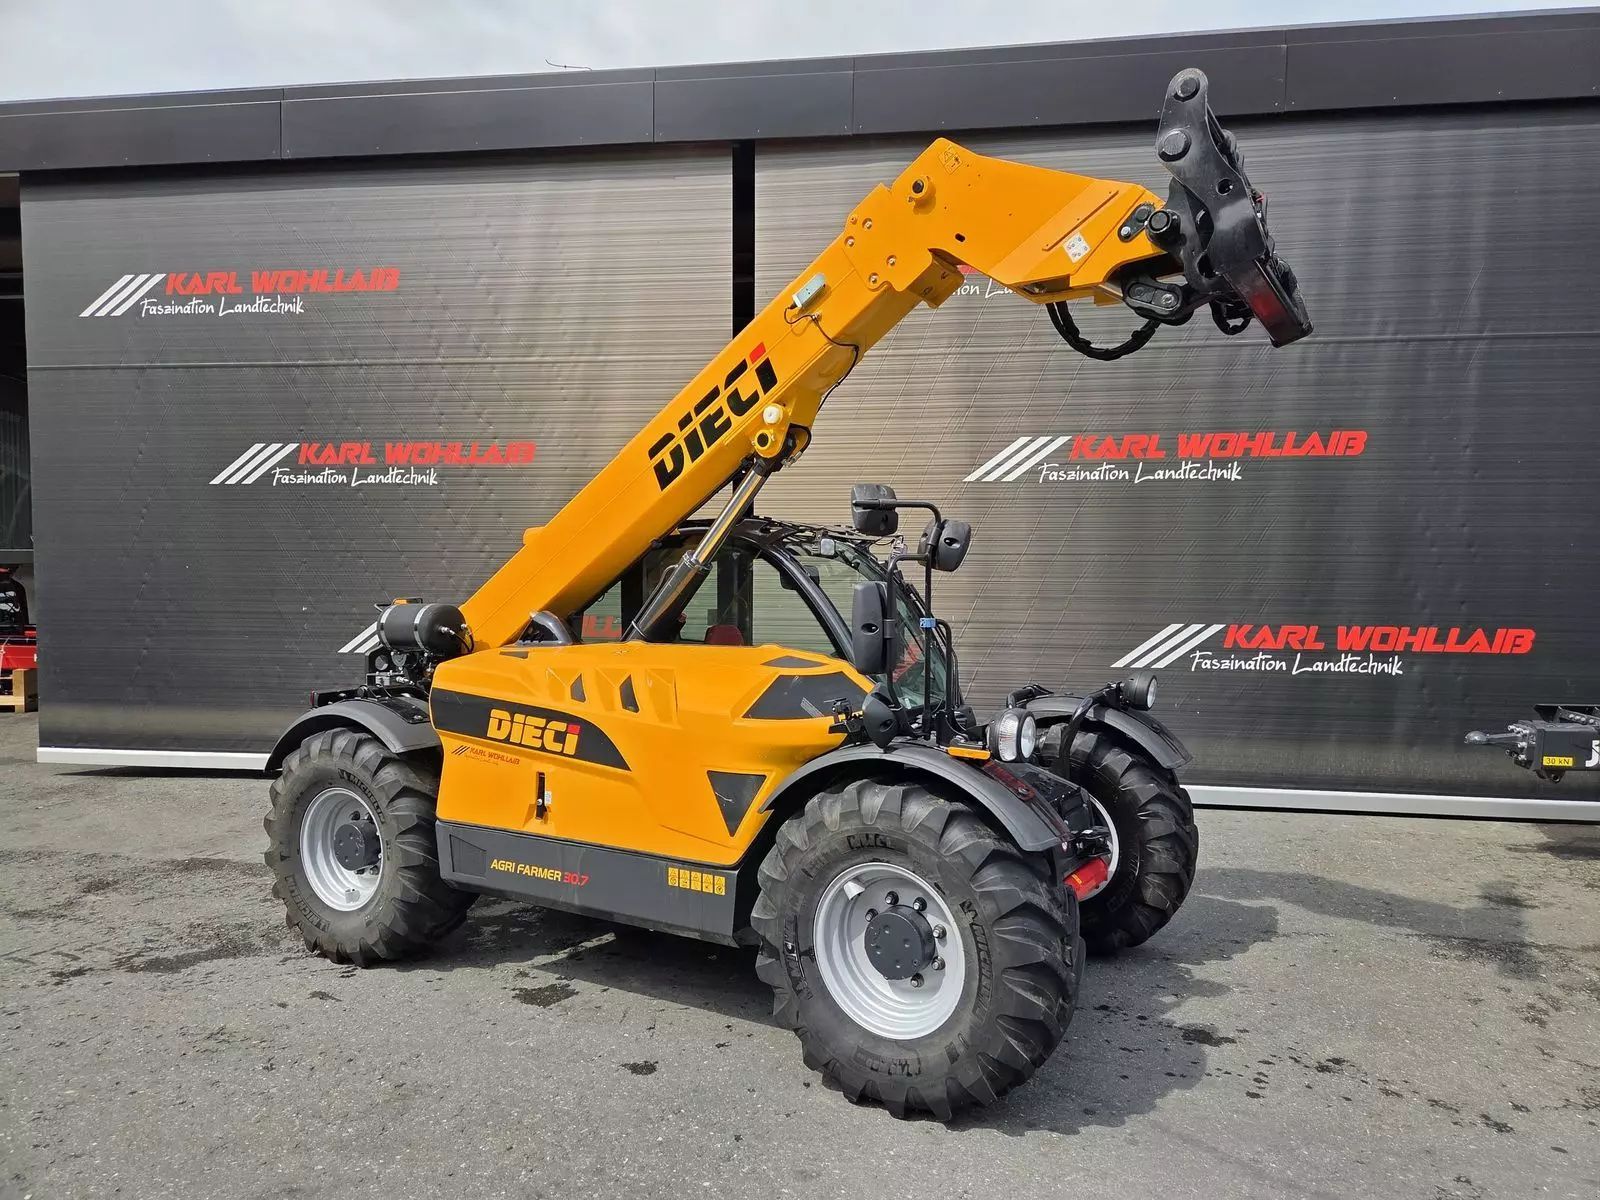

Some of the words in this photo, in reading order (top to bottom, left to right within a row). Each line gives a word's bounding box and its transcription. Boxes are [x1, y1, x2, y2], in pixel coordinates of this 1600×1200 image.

[165, 271, 243, 295] KARL
[251, 267, 400, 294] WOHLLAIB
[140, 297, 215, 317] Faszination
[219, 295, 304, 316] Landtechnik
[298, 442, 376, 464] KARL
[385, 441, 536, 464] WOHLLAIB
[1070, 434, 1166, 459] KARL
[1177, 431, 1368, 458] WOHLLAIB
[271, 467, 347, 486] Faszination
[351, 466, 438, 487] Landtechnik
[1038, 461, 1129, 483] Faszination
[1134, 460, 1242, 483] Landtechnik
[1223, 624, 1325, 649] KARL
[1337, 625, 1536, 653] WOHLLAIB
[1190, 650, 1286, 671] Faszination
[1292, 652, 1403, 675] Landtechnik
[1546, 757, 1556, 765] 30
[490, 859, 516, 873] AGRI
[516, 864, 562, 882] FARMER
[563, 871, 590, 887] 30.7
